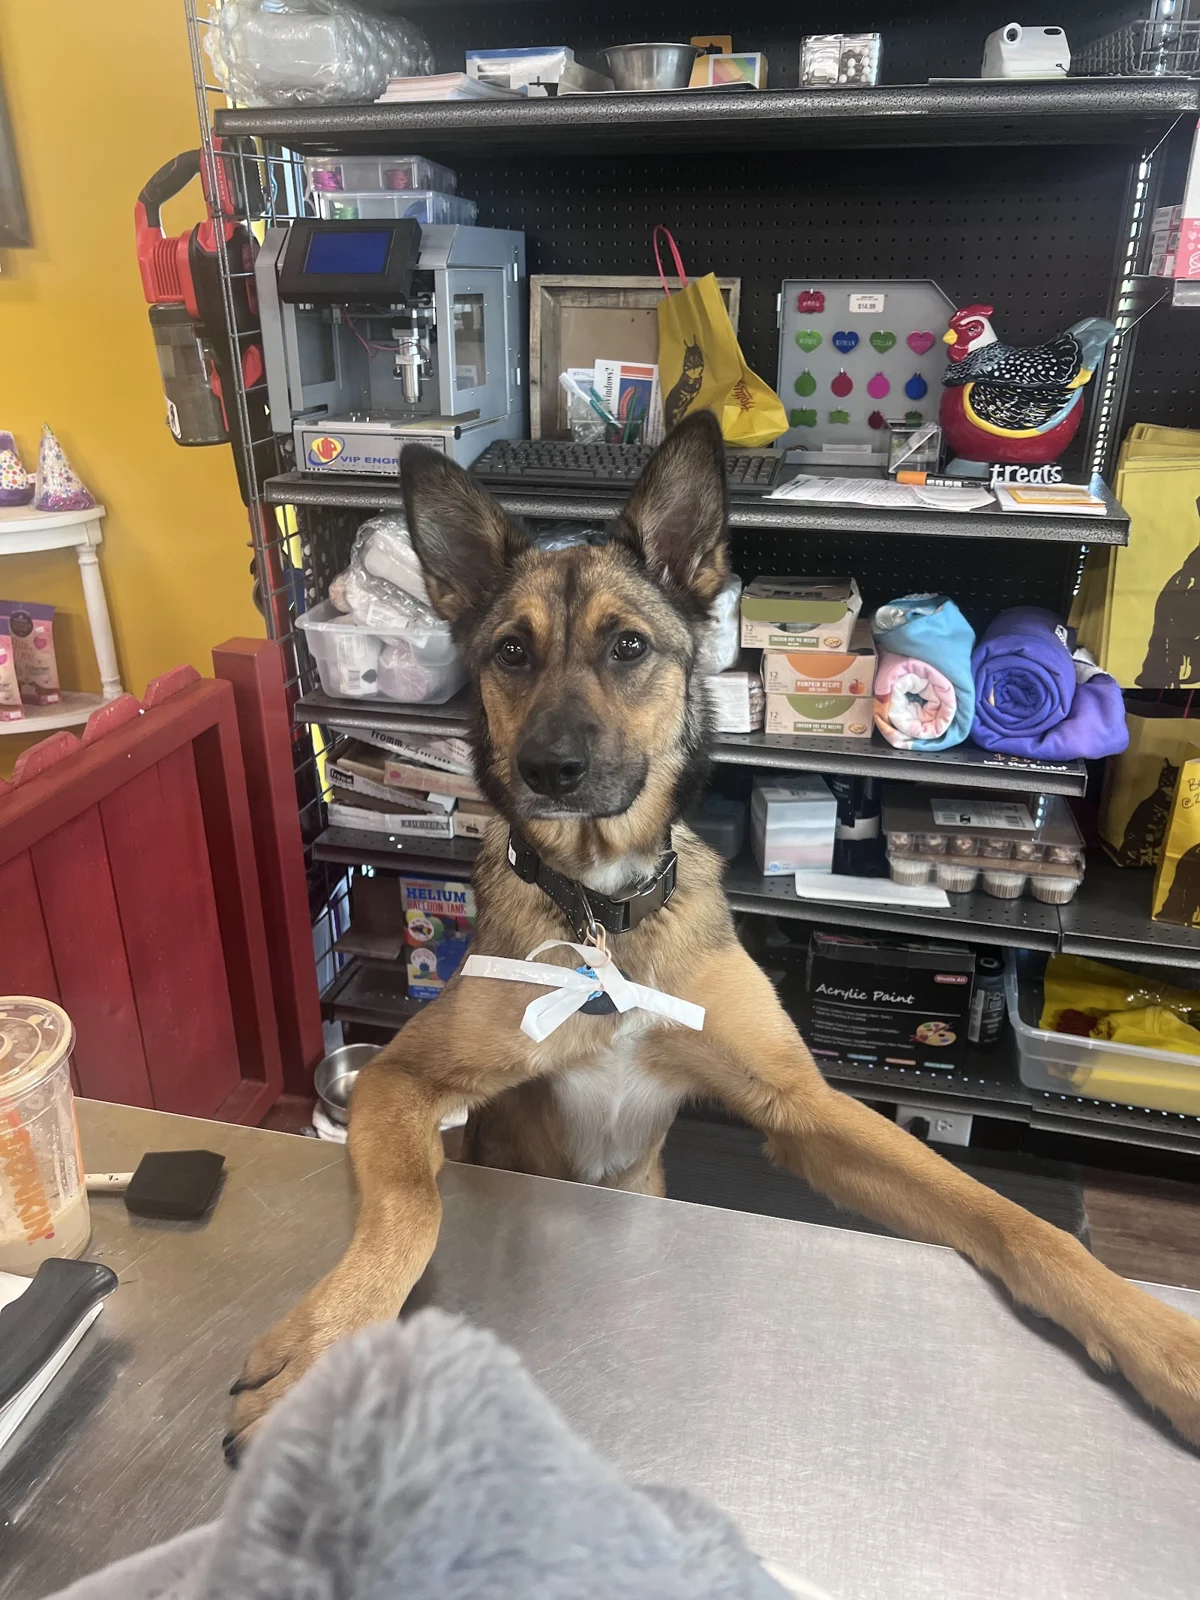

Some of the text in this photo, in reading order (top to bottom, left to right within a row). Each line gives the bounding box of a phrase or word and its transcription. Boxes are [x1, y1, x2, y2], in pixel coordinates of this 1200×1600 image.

[990, 464, 1062, 484] treats
[745, 624, 754, 632] 12
[769, 671, 778, 679] 12
[769, 711, 779, 719] 12
[371, 730, 403, 747] fromm
[1188, 778, 1200, 792] B
[406, 888, 467, 904] HELIUM
[407, 900, 467, 916] BALLOON TANK
[815, 983, 915, 1005] Acrylic Paint
